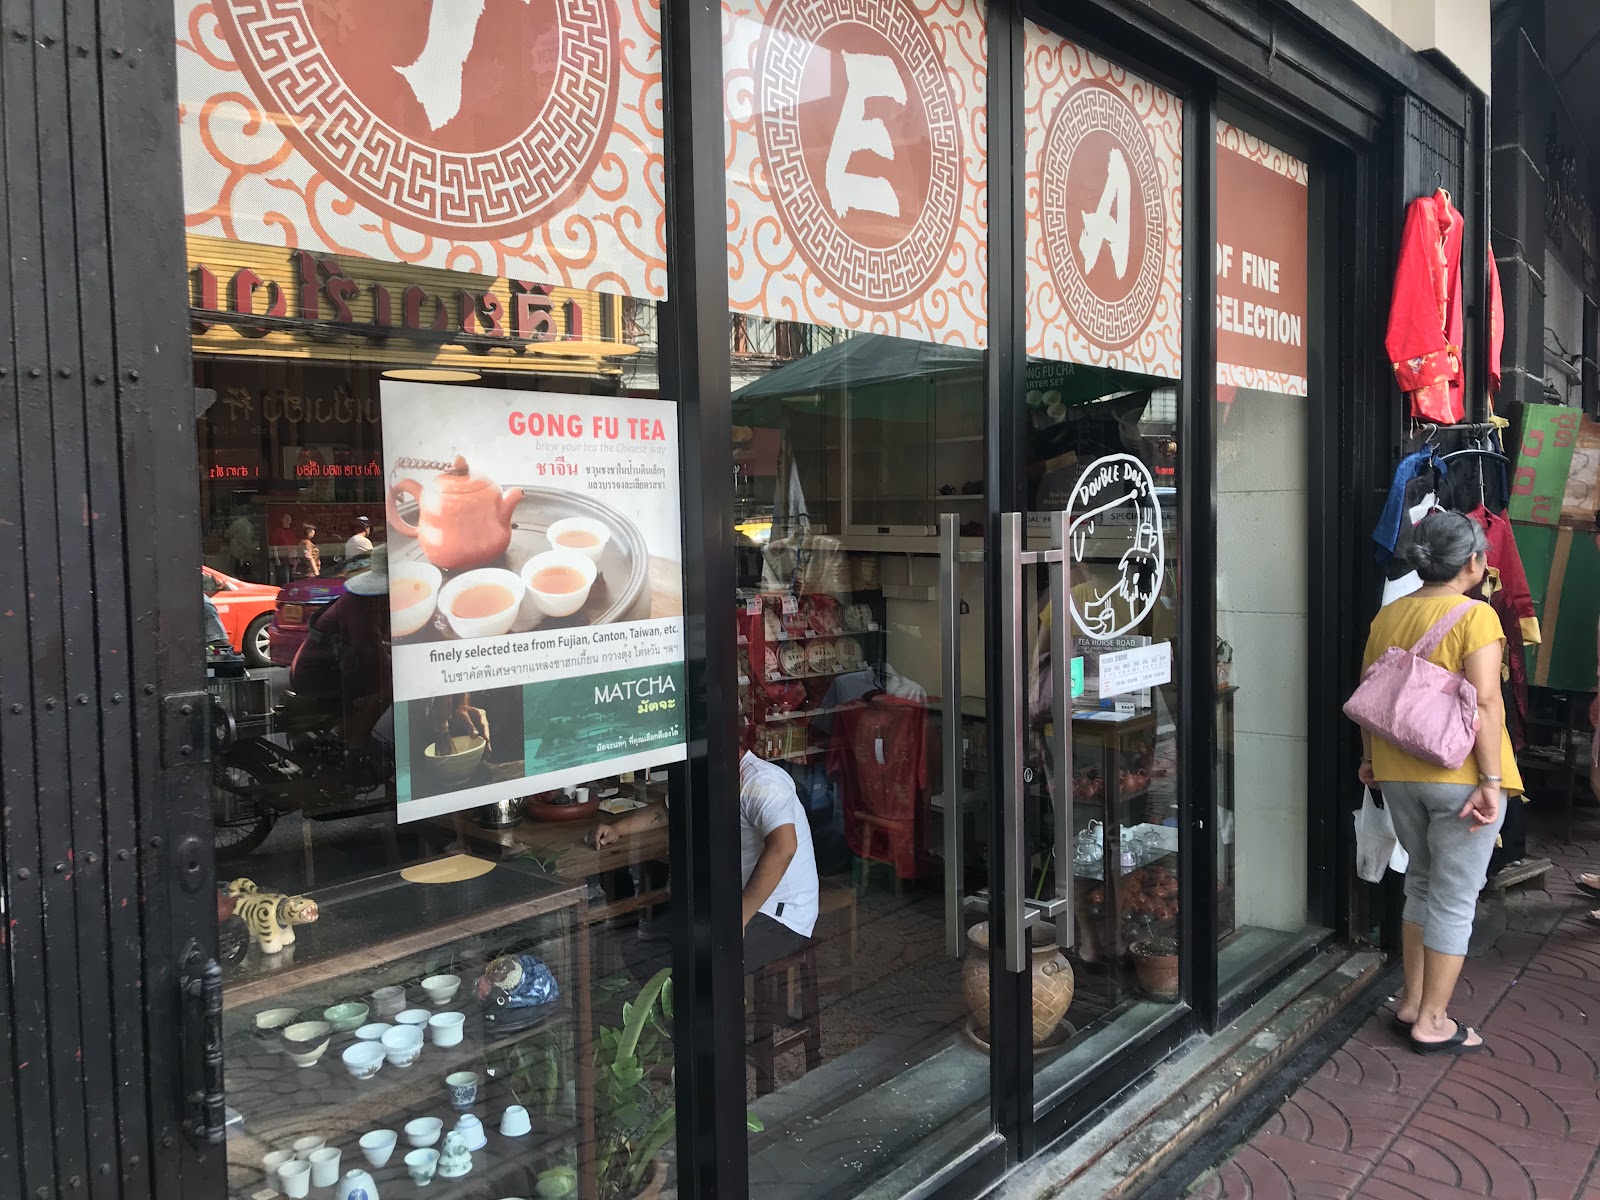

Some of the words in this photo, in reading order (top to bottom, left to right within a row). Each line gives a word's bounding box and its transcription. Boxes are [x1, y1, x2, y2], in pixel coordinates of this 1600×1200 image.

[1242, 251, 1280, 294] FINE
[1042, 364, 1054, 378] FU
[1056, 363, 1075, 376] CHA
[1049, 377, 1064, 387] SET
[508, 411, 583, 438] GONG
[593, 416, 619, 440] FU
[627, 418, 666, 441] TEA
[535, 440, 559, 452] brew
[561, 442, 582, 454] your
[584, 442, 598, 453] tea
[600, 442, 614, 453] the
[616, 443, 647, 454] Chinese
[649, 445, 667, 456] way
[536, 455, 578, 476] ชาจีน
[1080, 464, 1120, 505] DOUBLE
[429, 647, 462, 663] finely
[464, 641, 511, 659] selected
[512, 641, 529, 653] tea
[531, 638, 556, 652] from
[558, 634, 590, 651] Fujian,
[592, 630, 628, 644] Canton,
[629, 626, 662, 640] Taiwan,
[663, 624, 679, 636] etc.
[1078, 638, 1090, 646] TEA
[1092, 639, 1114, 647] HORSE
[1116, 639, 1136, 647] ROAD
[594, 674, 676, 705] MATCHA
